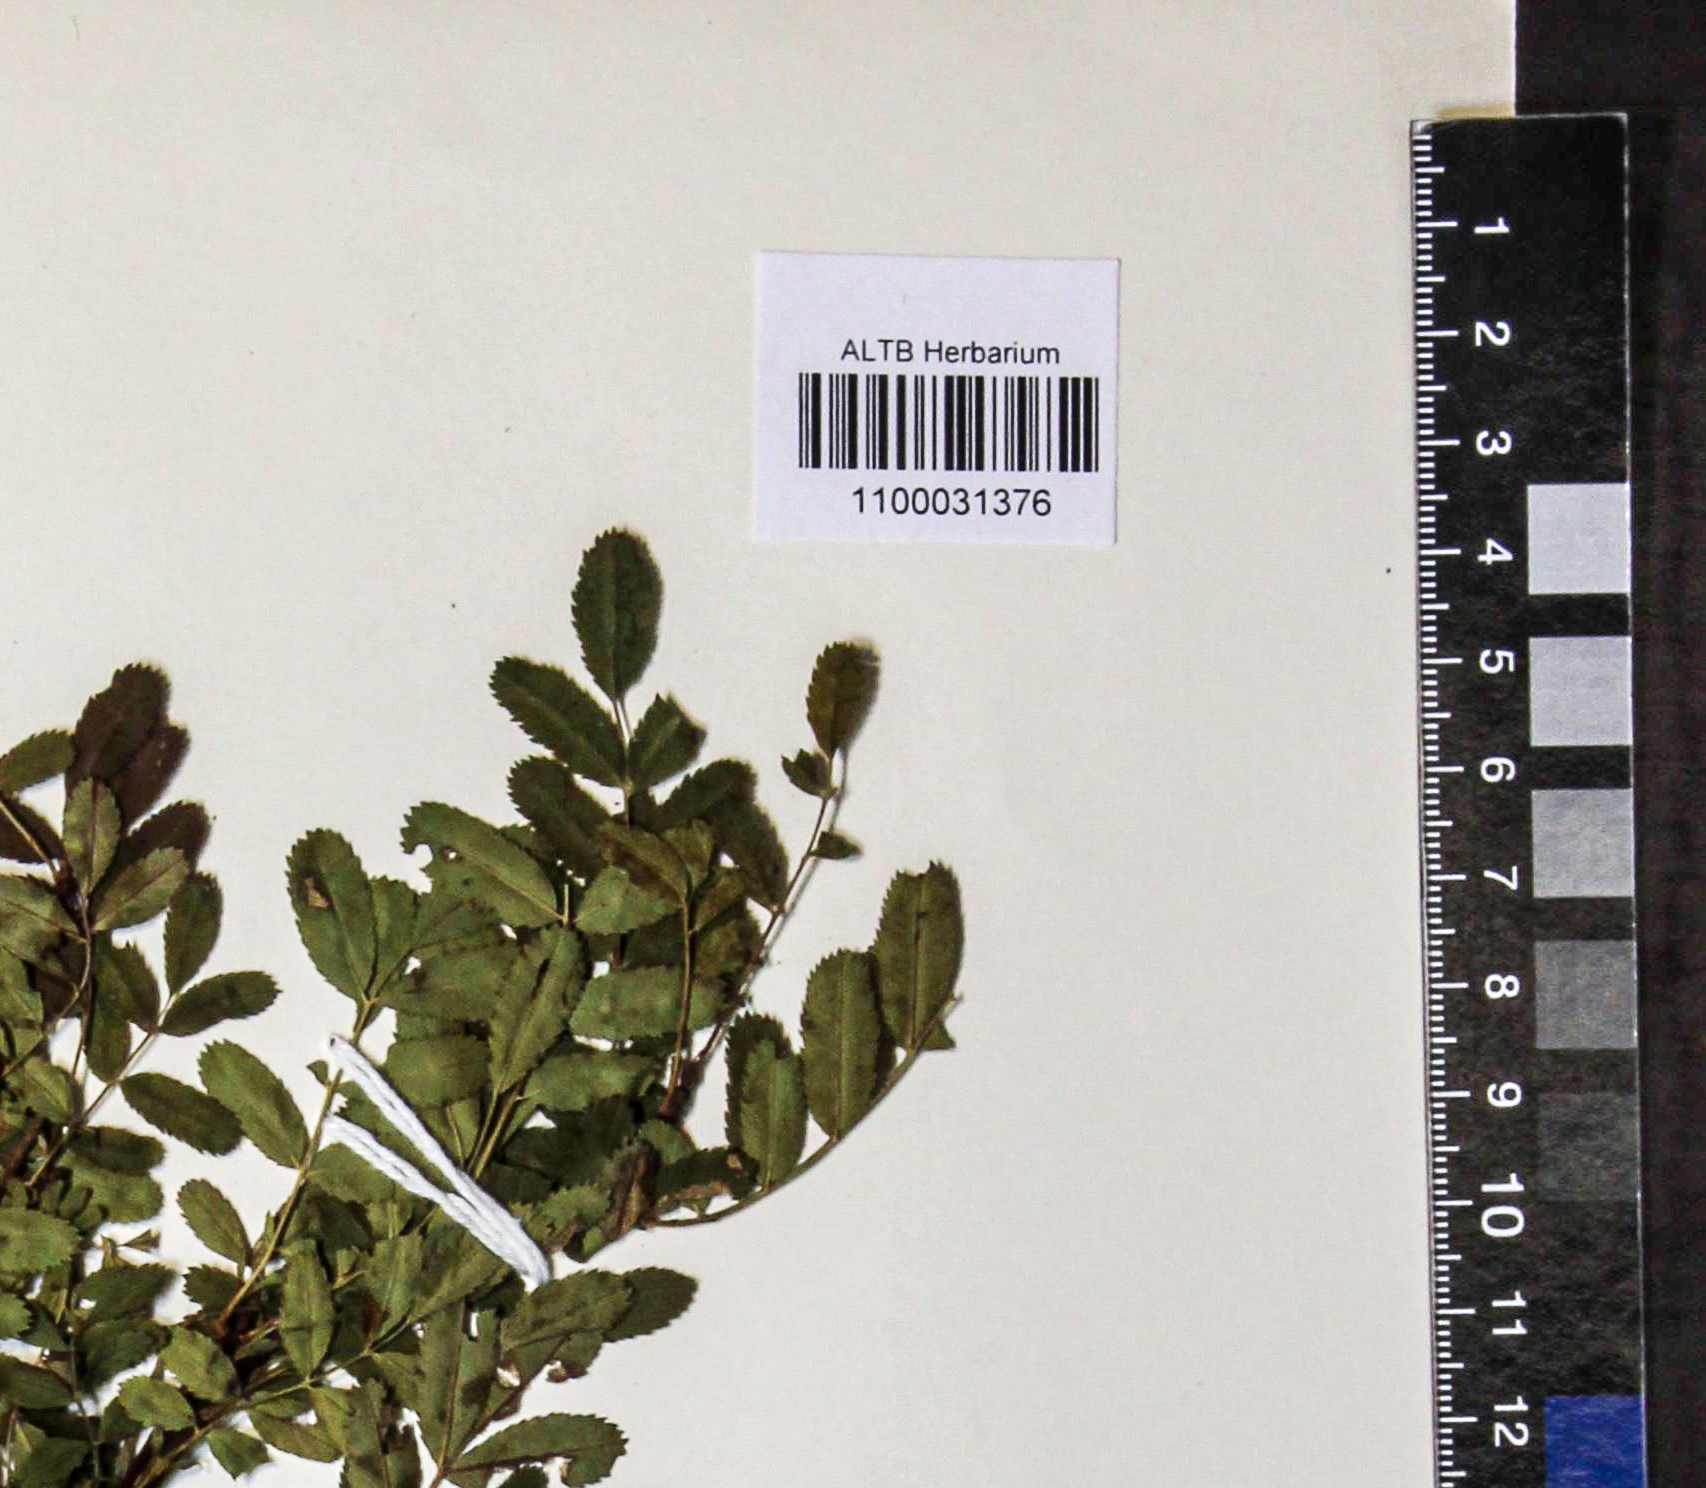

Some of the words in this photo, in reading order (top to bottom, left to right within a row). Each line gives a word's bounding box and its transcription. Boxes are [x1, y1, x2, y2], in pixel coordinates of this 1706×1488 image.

[1473, 216, 1510, 235] 1
[1474, 321, 1511, 347] 2
[840, 338, 914, 363] ALTB
[923, 339, 1061, 366] Herbarium
[1475, 429, 1513, 457] 3
[851, 485, 1052, 517] 1100031376
[1477, 538, 1513, 566] 4
[1479, 649, 1515, 674] 5
[1480, 757, 1516, 783] 6
[1483, 865, 1519, 892] 7
[1483, 973, 1521, 1000] 8
[1486, 1081, 1523, 1109] 9
[1480, 1172, 1525, 1238] 10
[1491, 1290, 1528, 1336] 11
[1493, 1395, 1530, 1448] 12
